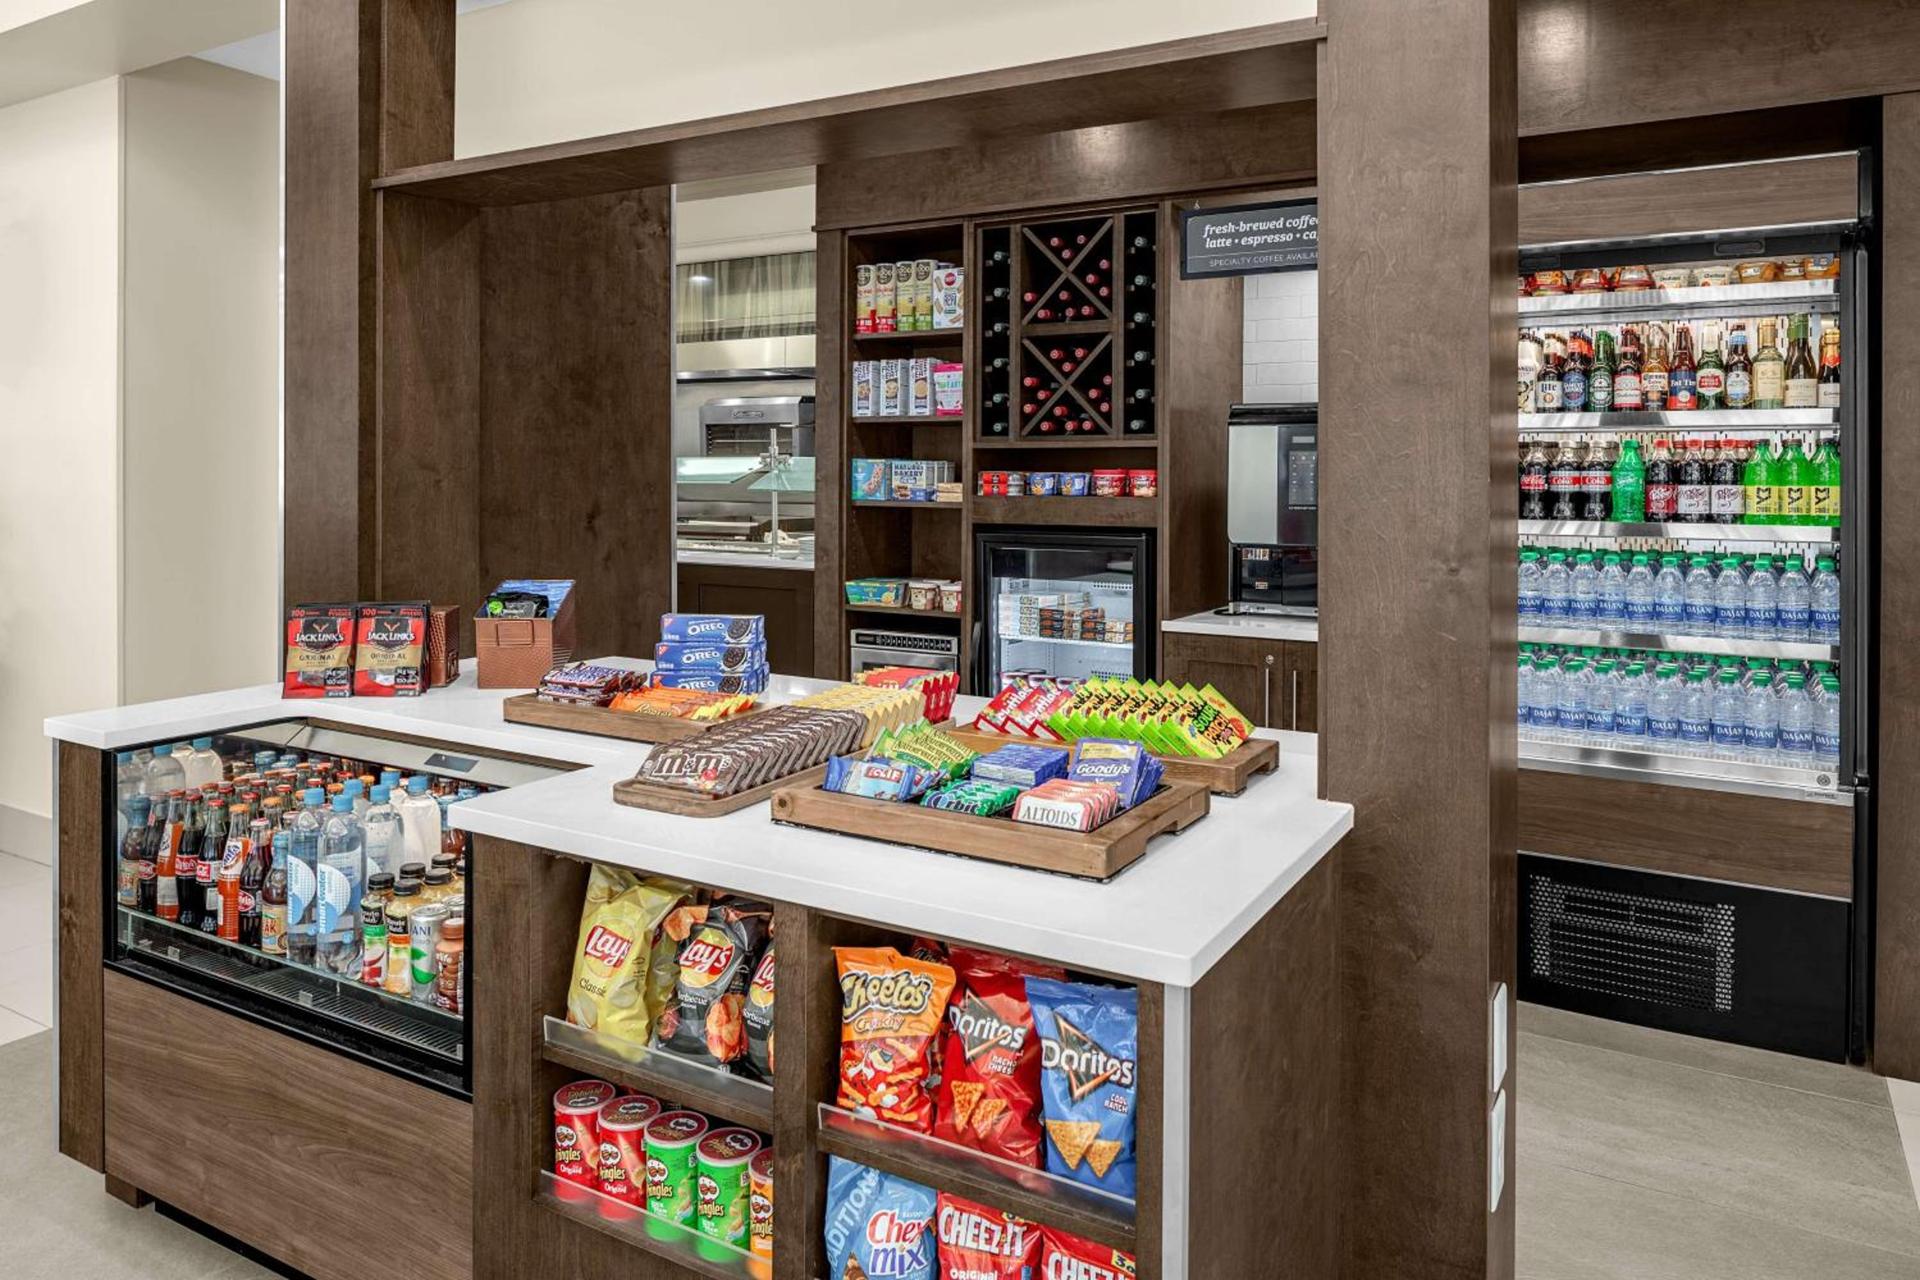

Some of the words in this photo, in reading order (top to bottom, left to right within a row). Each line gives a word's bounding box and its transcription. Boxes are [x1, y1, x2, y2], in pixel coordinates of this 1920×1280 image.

[1203, 217, 1284, 238] fresh-brewed
[1205, 237, 1232, 248] latte
[1241, 231, 1293, 247] espresso
[1302, 230, 1318, 241] ca
[1210, 256, 1251, 267] SPECIALTY
[1253, 254, 1284, 264] COFFEE
[295, 633, 318, 642] JACK
[367, 632, 389, 641] JACK
[688, 622, 725, 636] OREO
[682, 651, 720, 664] OREO
[1193, 704, 1218, 732] SOUR
[1204, 713, 1230, 745] PATCH
[1077, 763, 1131, 776] Goody's
[1022, 805, 1078, 827] ALTOIDS
[679, 941, 731, 973] Lay's
[841, 970, 931, 1019] Cheetos
[949, 1005, 1028, 1049] Doritos
[1041, 1038, 1134, 1086] Doritos
[1104, 1100, 1128, 1113] RANCH
[1111, 1094, 1127, 1105] COOL
[866, 1209, 933, 1246] Chex
